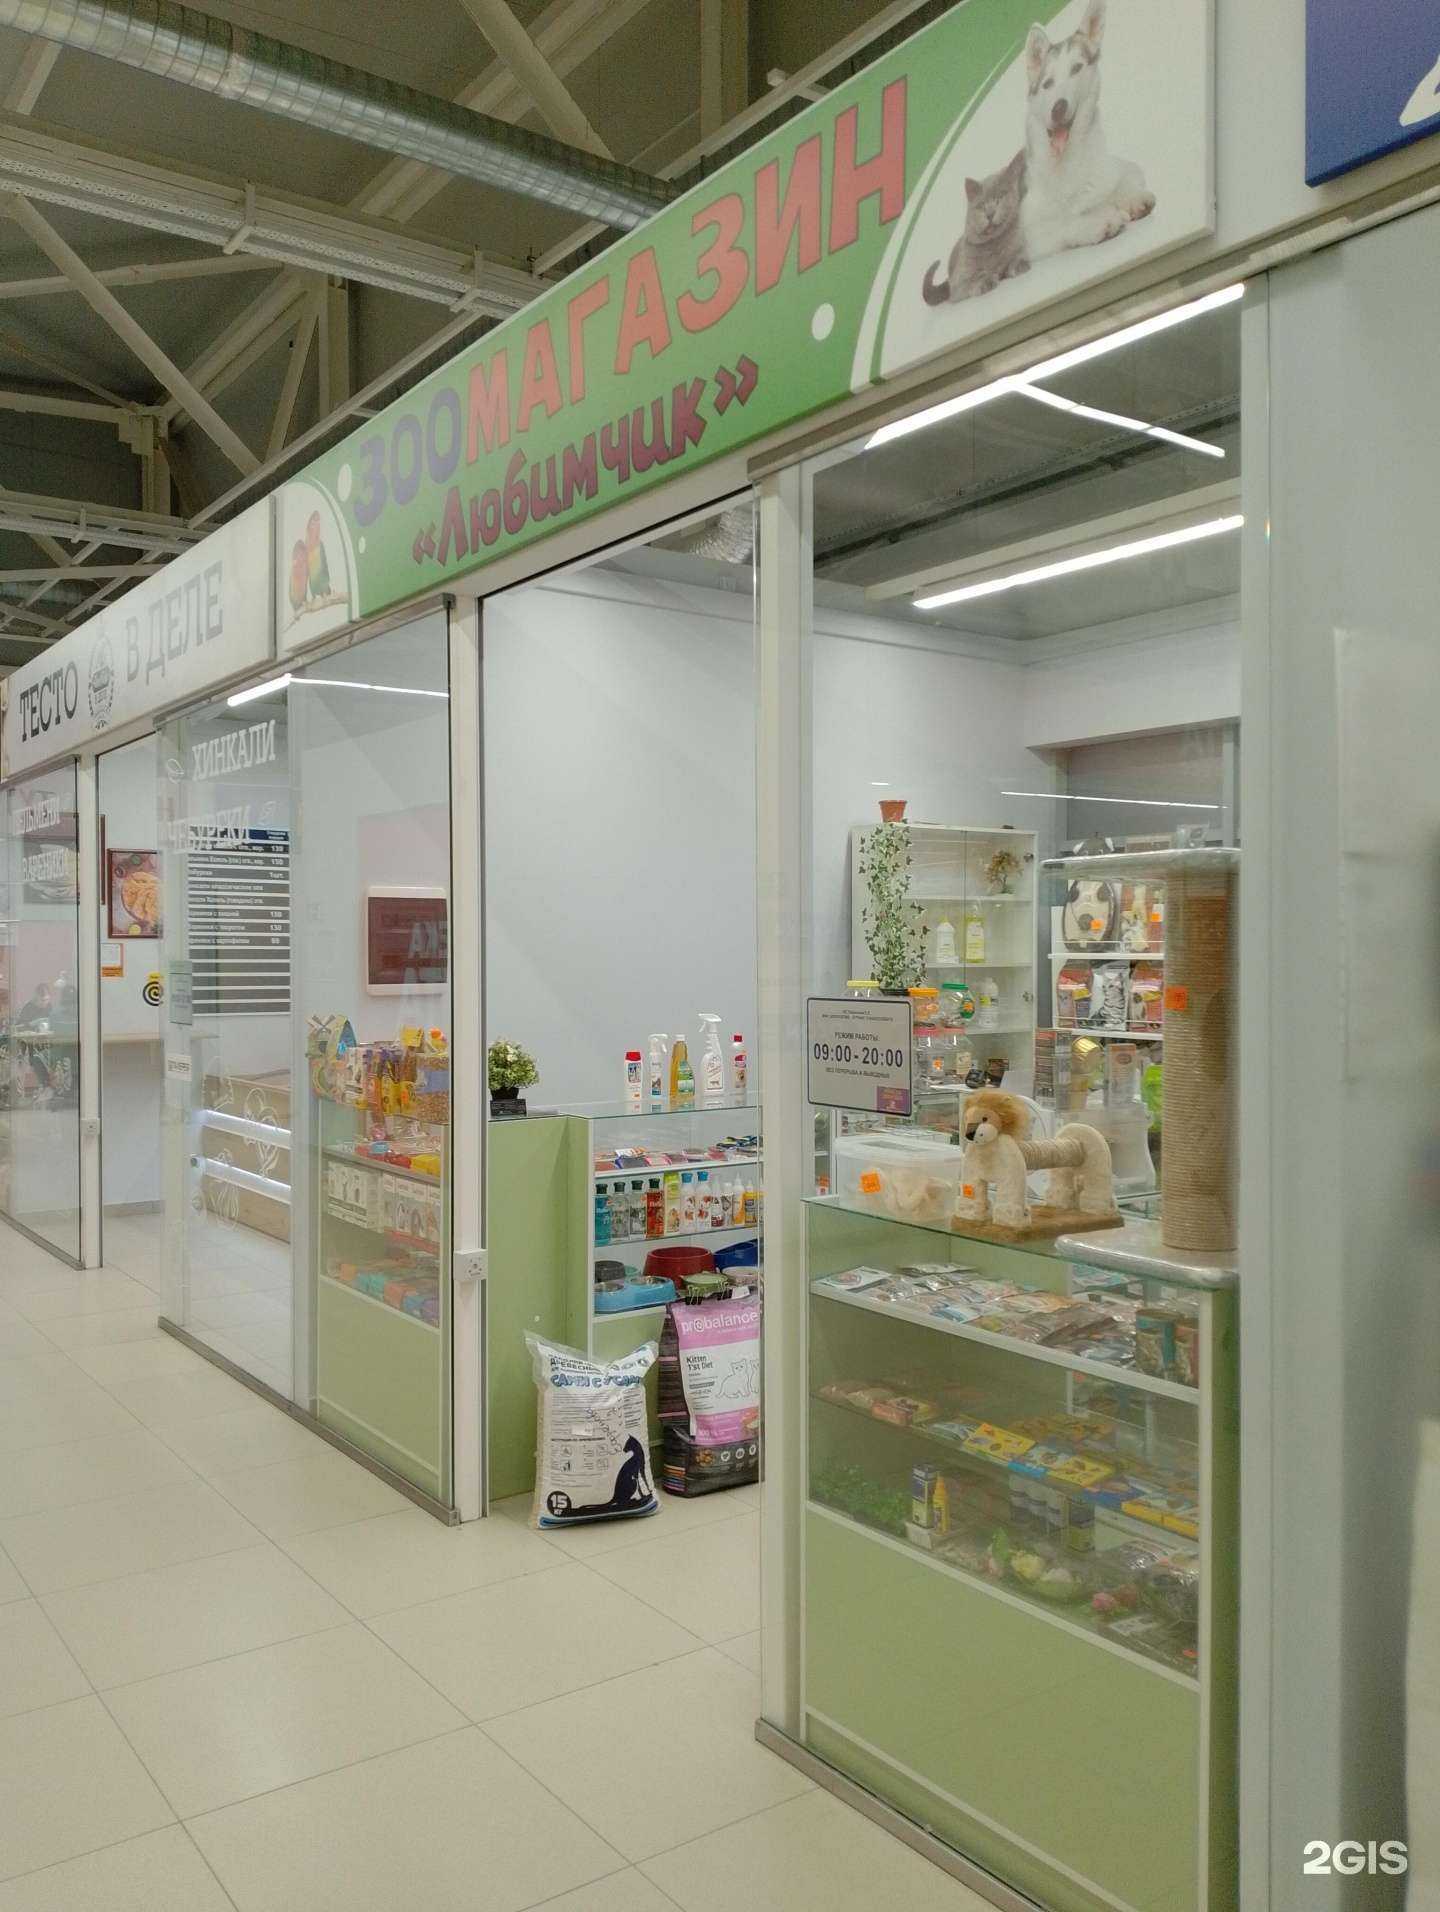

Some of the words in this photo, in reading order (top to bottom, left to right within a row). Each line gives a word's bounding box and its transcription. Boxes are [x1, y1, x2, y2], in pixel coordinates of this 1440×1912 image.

[353, 74, 909, 528] ЗООМАГАЗИН
[411, 353, 760, 567] «Любимчик»
[19, 660, 79, 743] ТЕСТО
[126, 615, 140, 688] В
[145, 560, 224, 686] ДЕЛЕ
[191, 719, 276, 782] ХИНКАЛИ
[813, 1042, 852, 1063] 09:00
[861, 1047, 904, 1068] 20:00
[550, 1494, 568, 1509] 15
